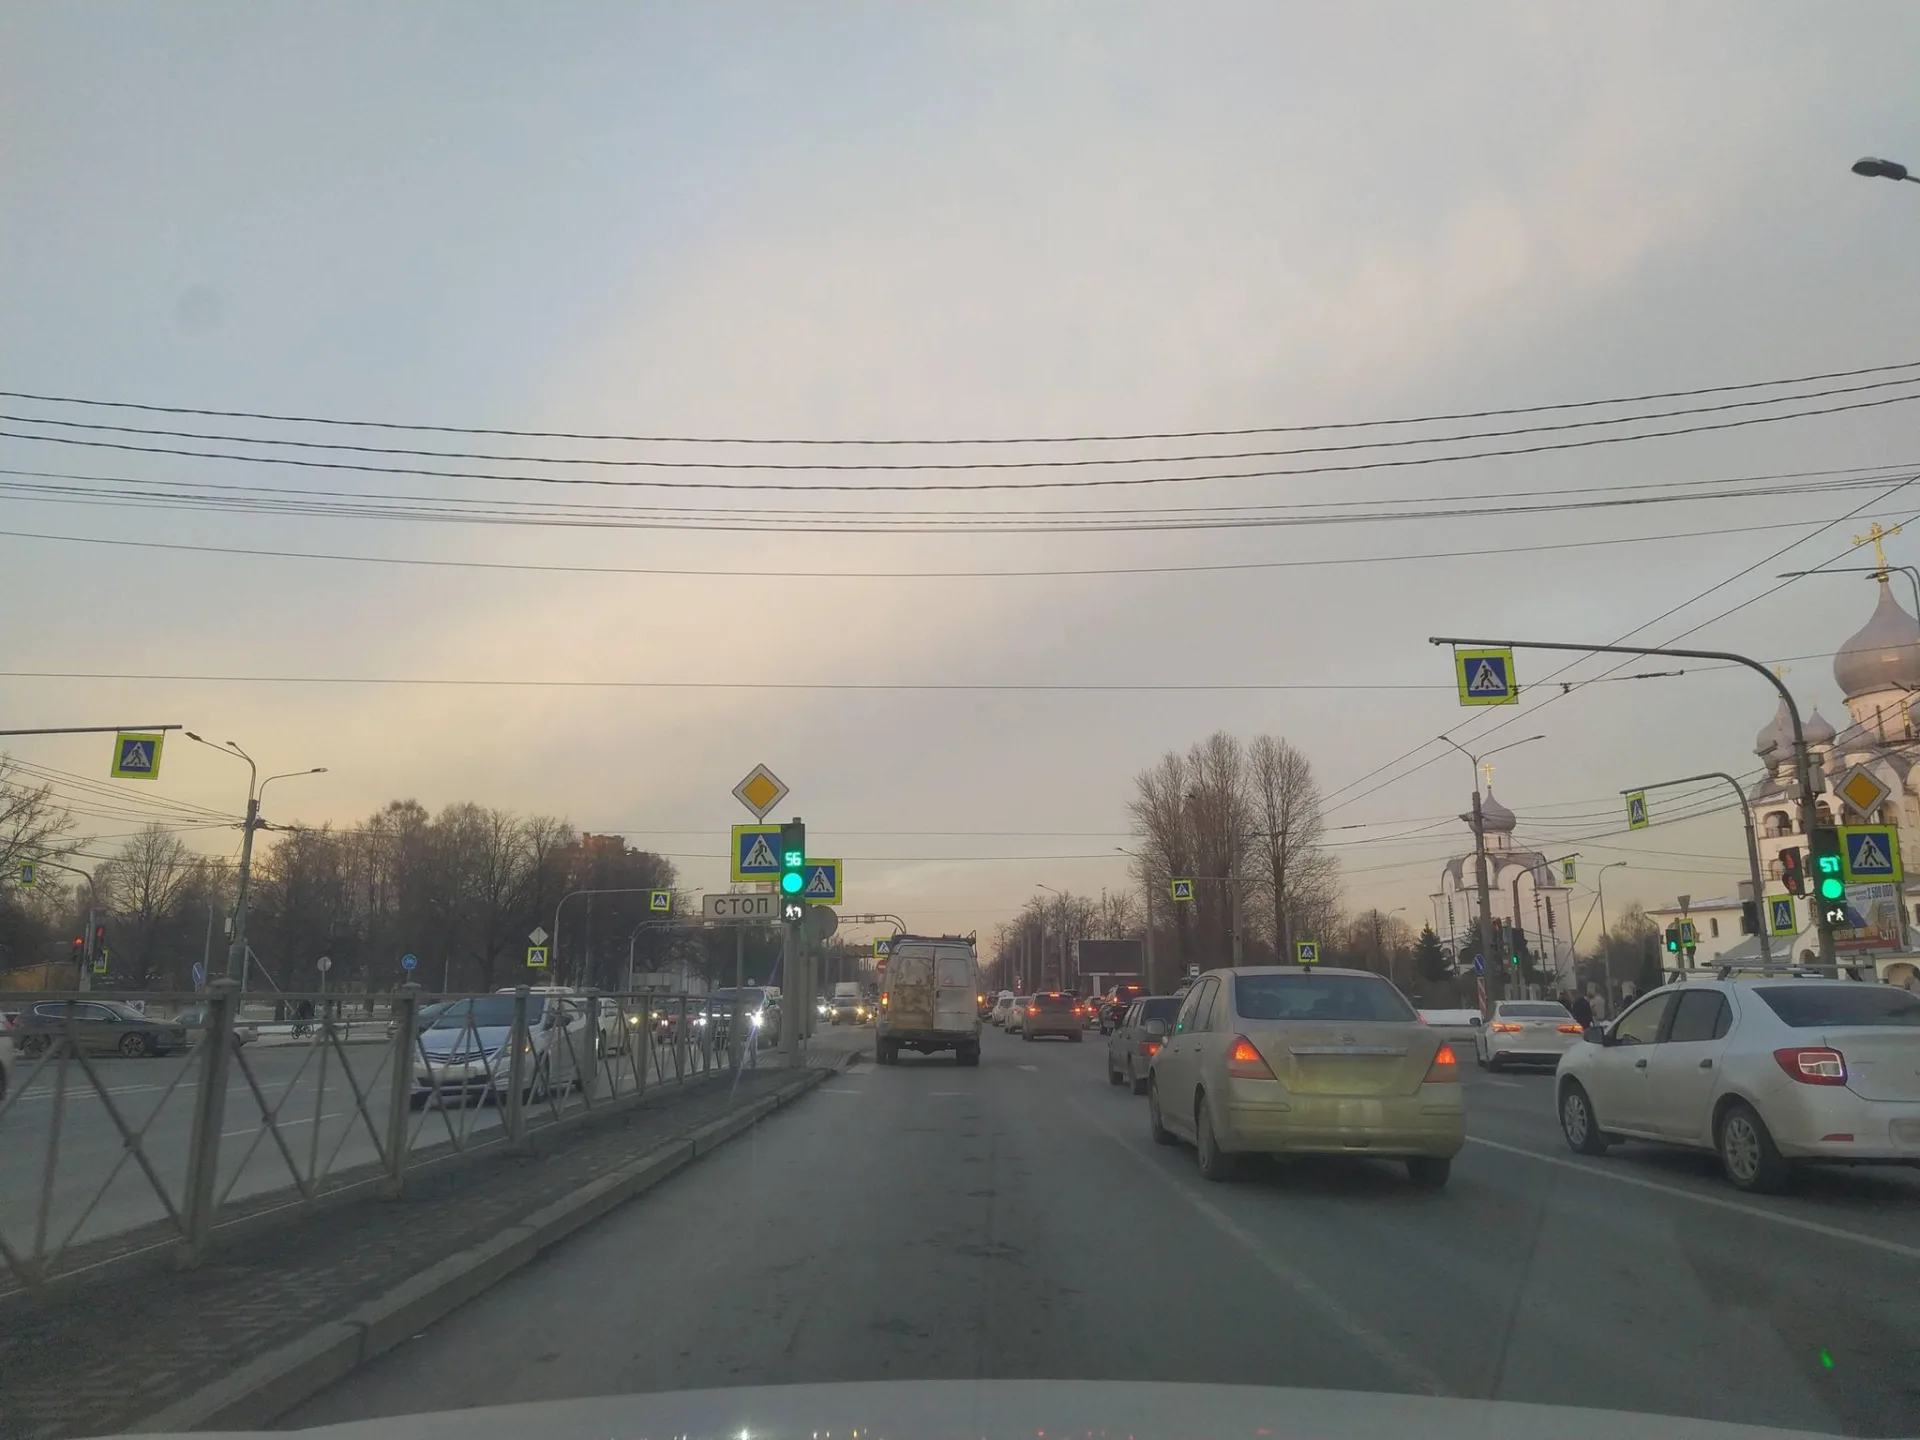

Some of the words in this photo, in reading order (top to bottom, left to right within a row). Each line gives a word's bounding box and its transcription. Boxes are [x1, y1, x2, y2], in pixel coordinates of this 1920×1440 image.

[785, 852, 802, 867] 56
[1819, 856, 1839, 873] 57
[714, 898, 768, 915] СТОП
